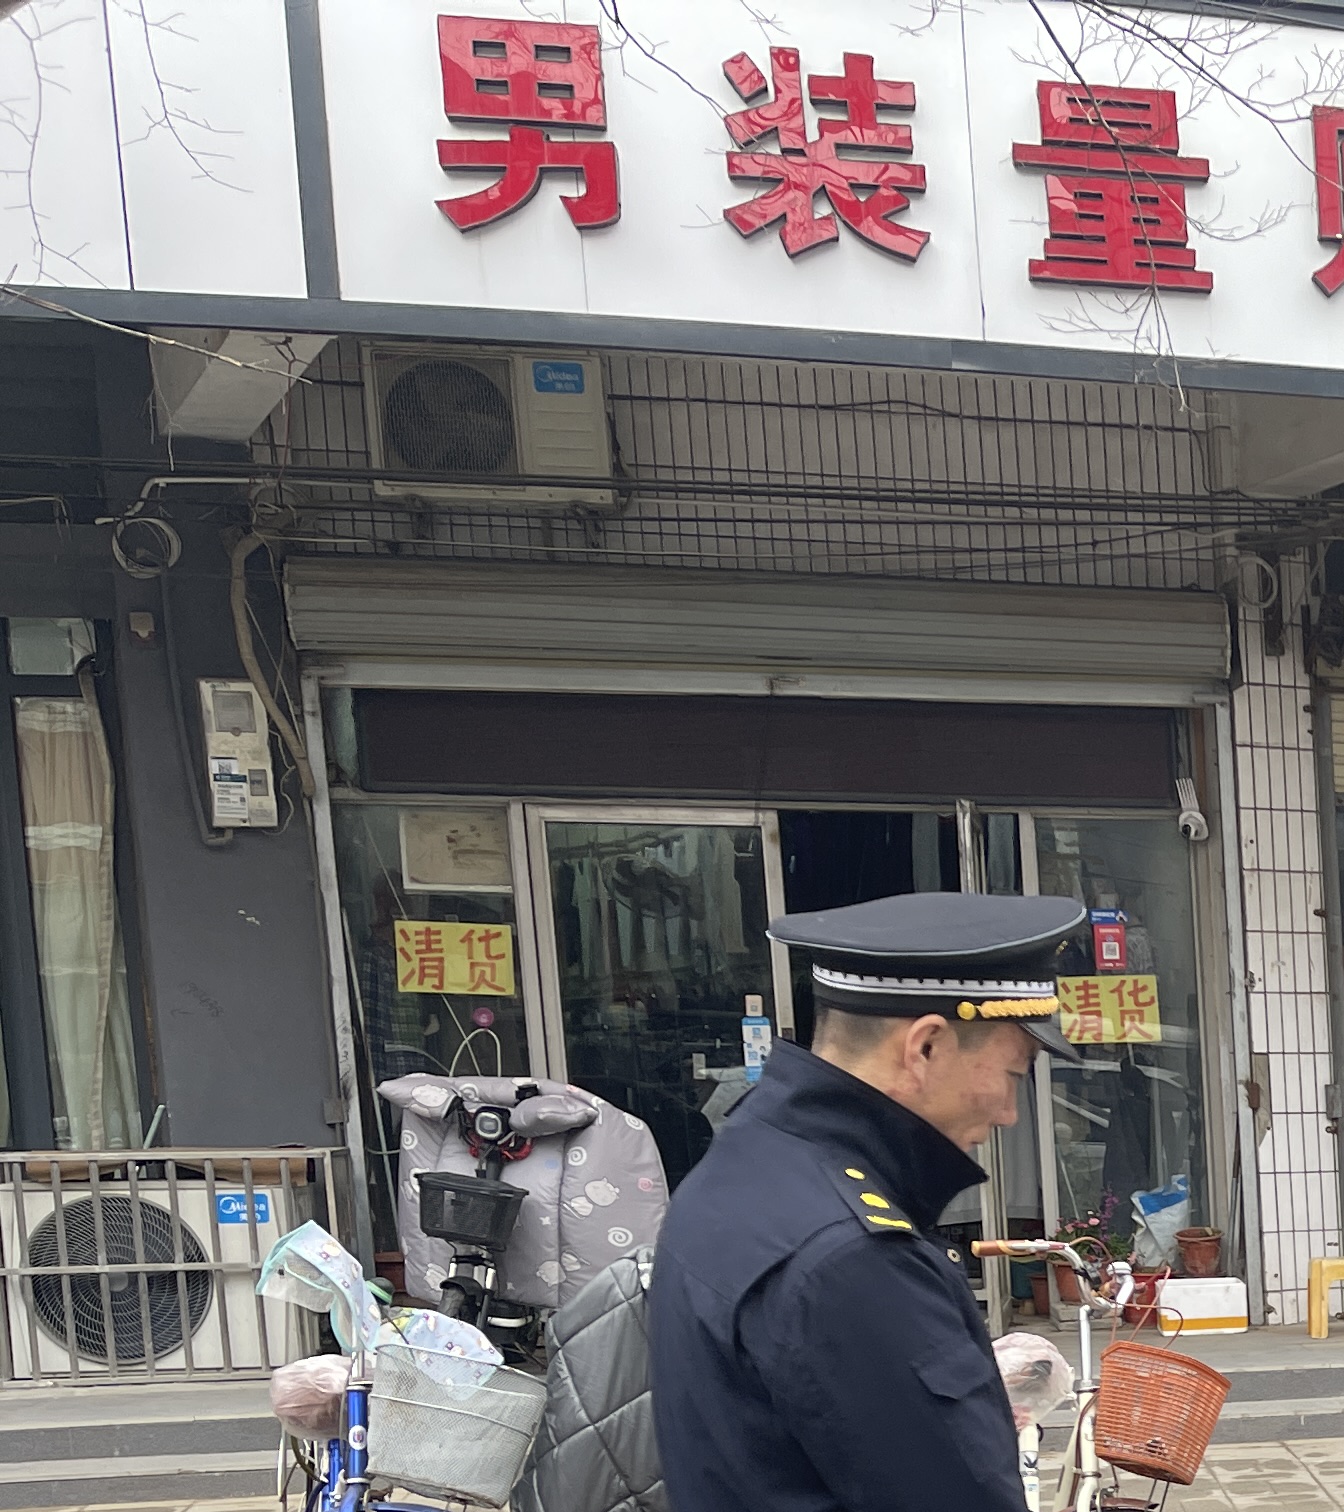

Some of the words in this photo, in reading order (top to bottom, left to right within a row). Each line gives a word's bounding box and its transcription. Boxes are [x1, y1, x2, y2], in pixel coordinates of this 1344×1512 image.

[398, 927, 506, 993] 清货
[1060, 979, 1156, 1042] 清货
[229, 1201, 267, 1213] Miea
